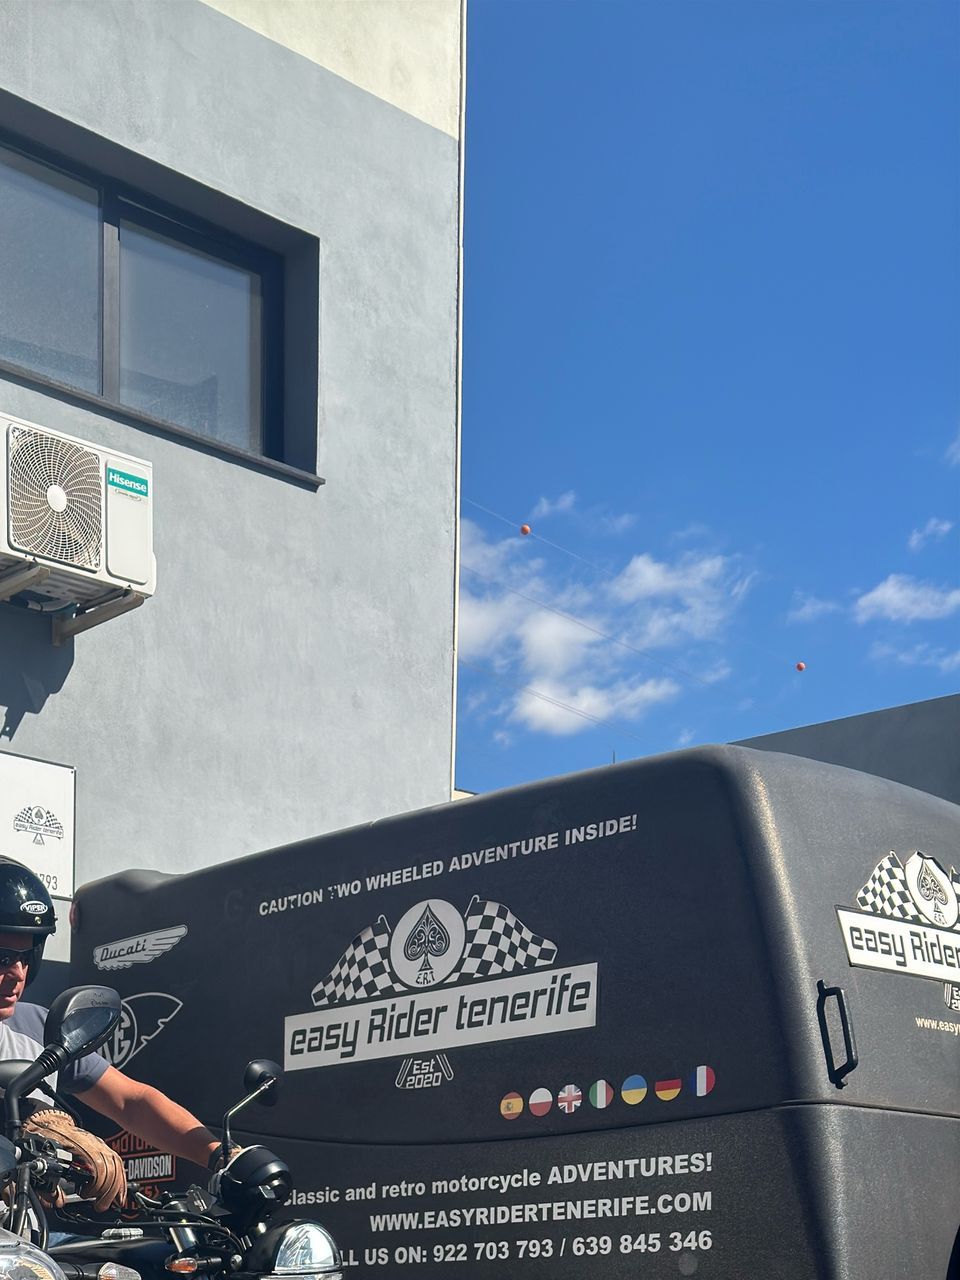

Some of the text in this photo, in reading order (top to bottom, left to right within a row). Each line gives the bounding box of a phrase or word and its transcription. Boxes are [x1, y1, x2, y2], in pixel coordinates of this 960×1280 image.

[109, 471, 147, 493] Hisense
[258, 888, 324, 917] CAUTION
[365, 860, 445, 892] WHEELED
[448, 832, 559, 873] ADVENTURE
[564, 814, 638, 846] INSIDE!
[100, 937, 148, 963] Ducati
[849, 925, 908, 968] easy
[289, 972, 592, 1059] easy Rider tenerife
[405, 1071, 442, 1088] 2020
[413, 1057, 437, 1075] Est
[345, 1182, 377, 1202] and
[381, 1180, 426, 1199] retro
[431, 1168, 542, 1195] motorcycle
[547, 1152, 713, 1186] ADVENTURES!
[369, 1191, 713, 1233] WWW.EASYRIDERTENERIFE.COM
[364, 1247, 389, 1266] US
[394, 1246, 427, 1265] ON:
[432, 1243, 468, 1262] 922
[473, 1241, 510, 1260] 703
[516, 1239, 554, 1259] 793
[559, 1238, 567, 1257] /
[572, 1236, 613, 1256] 639
[619, 1233, 662, 1253] 845
[668, 1230, 713, 1252] 346
